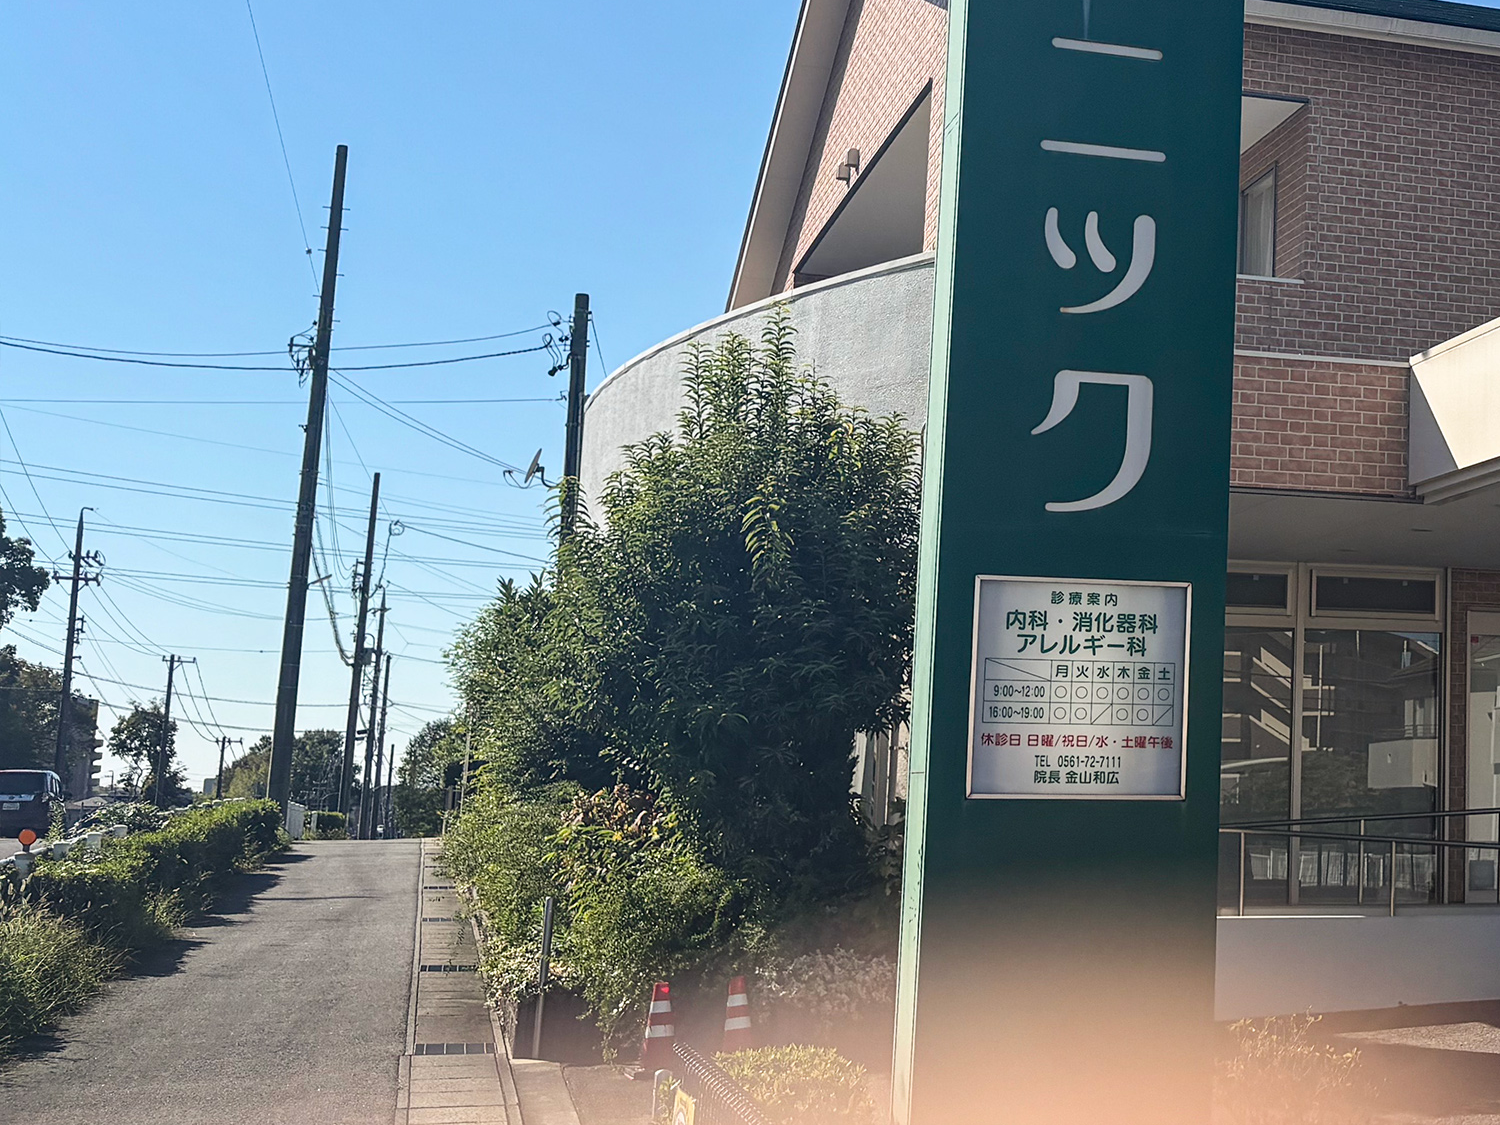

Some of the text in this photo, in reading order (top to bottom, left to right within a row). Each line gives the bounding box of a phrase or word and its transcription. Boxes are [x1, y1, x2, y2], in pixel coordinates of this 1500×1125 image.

[1050, 590, 1118, 606] 診療案内
[1016, 633, 1147, 657] アレルギー科
[1055, 664, 1171, 681] 月 火 水 木 金 土
[981, 732, 1021, 746] 休診日
[1034, 755, 1121, 768] TEL 0561-72-7111
[1033, 770, 1120, 785] 院長 金山和広
